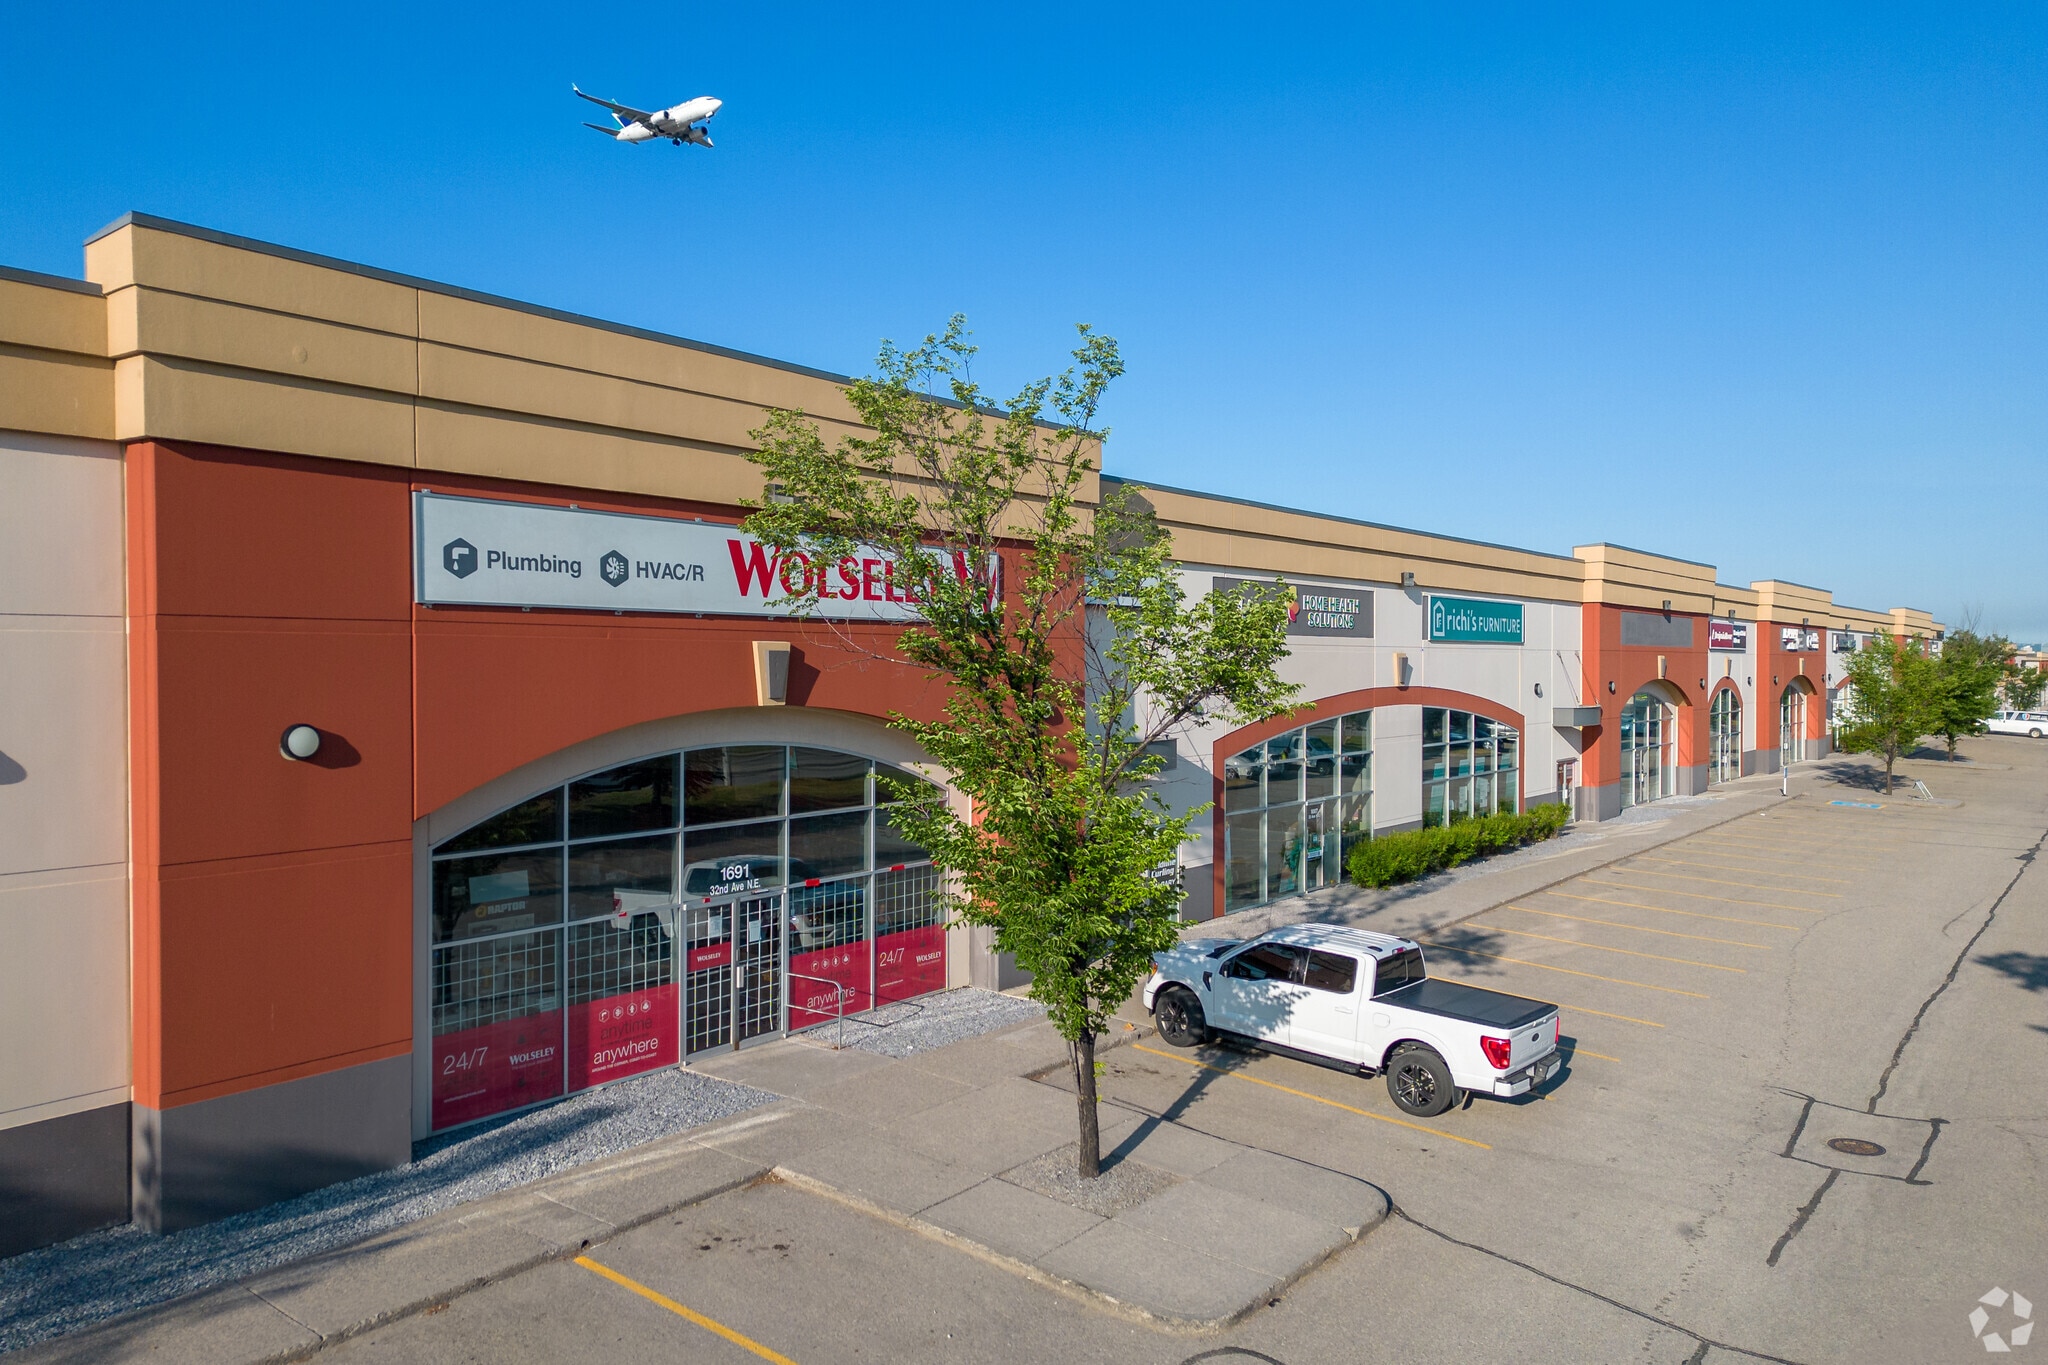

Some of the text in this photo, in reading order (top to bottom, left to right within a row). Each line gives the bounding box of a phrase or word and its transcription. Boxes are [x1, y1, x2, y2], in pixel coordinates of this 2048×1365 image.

[487, 550, 582, 578] Plumbing
[636, 561, 704, 581] HVAC/R
[1302, 595, 1360, 614] HOME HEALTH
[1308, 612, 1354, 629] SOLUTIONS
[1447, 608, 1521, 633] richi's FURNITURE
[720, 864, 749, 880] 1691
[1151, 867, 1175, 879] Curling
[710, 879, 761, 896] 32nd Ave N.E.
[487, 900, 526, 915] RAPTOR
[697, 952, 721, 963] WOLSELEY
[879, 947, 905, 967] 24/7
[916, 951, 941, 963] WOLSELEY
[807, 986, 856, 1008] anywhre
[600, 1018, 653, 1040] anytime
[443, 1046, 489, 1075] 24/7
[509, 1046, 555, 1066] WOLSELEY
[593, 1037, 659, 1065] anywhere
